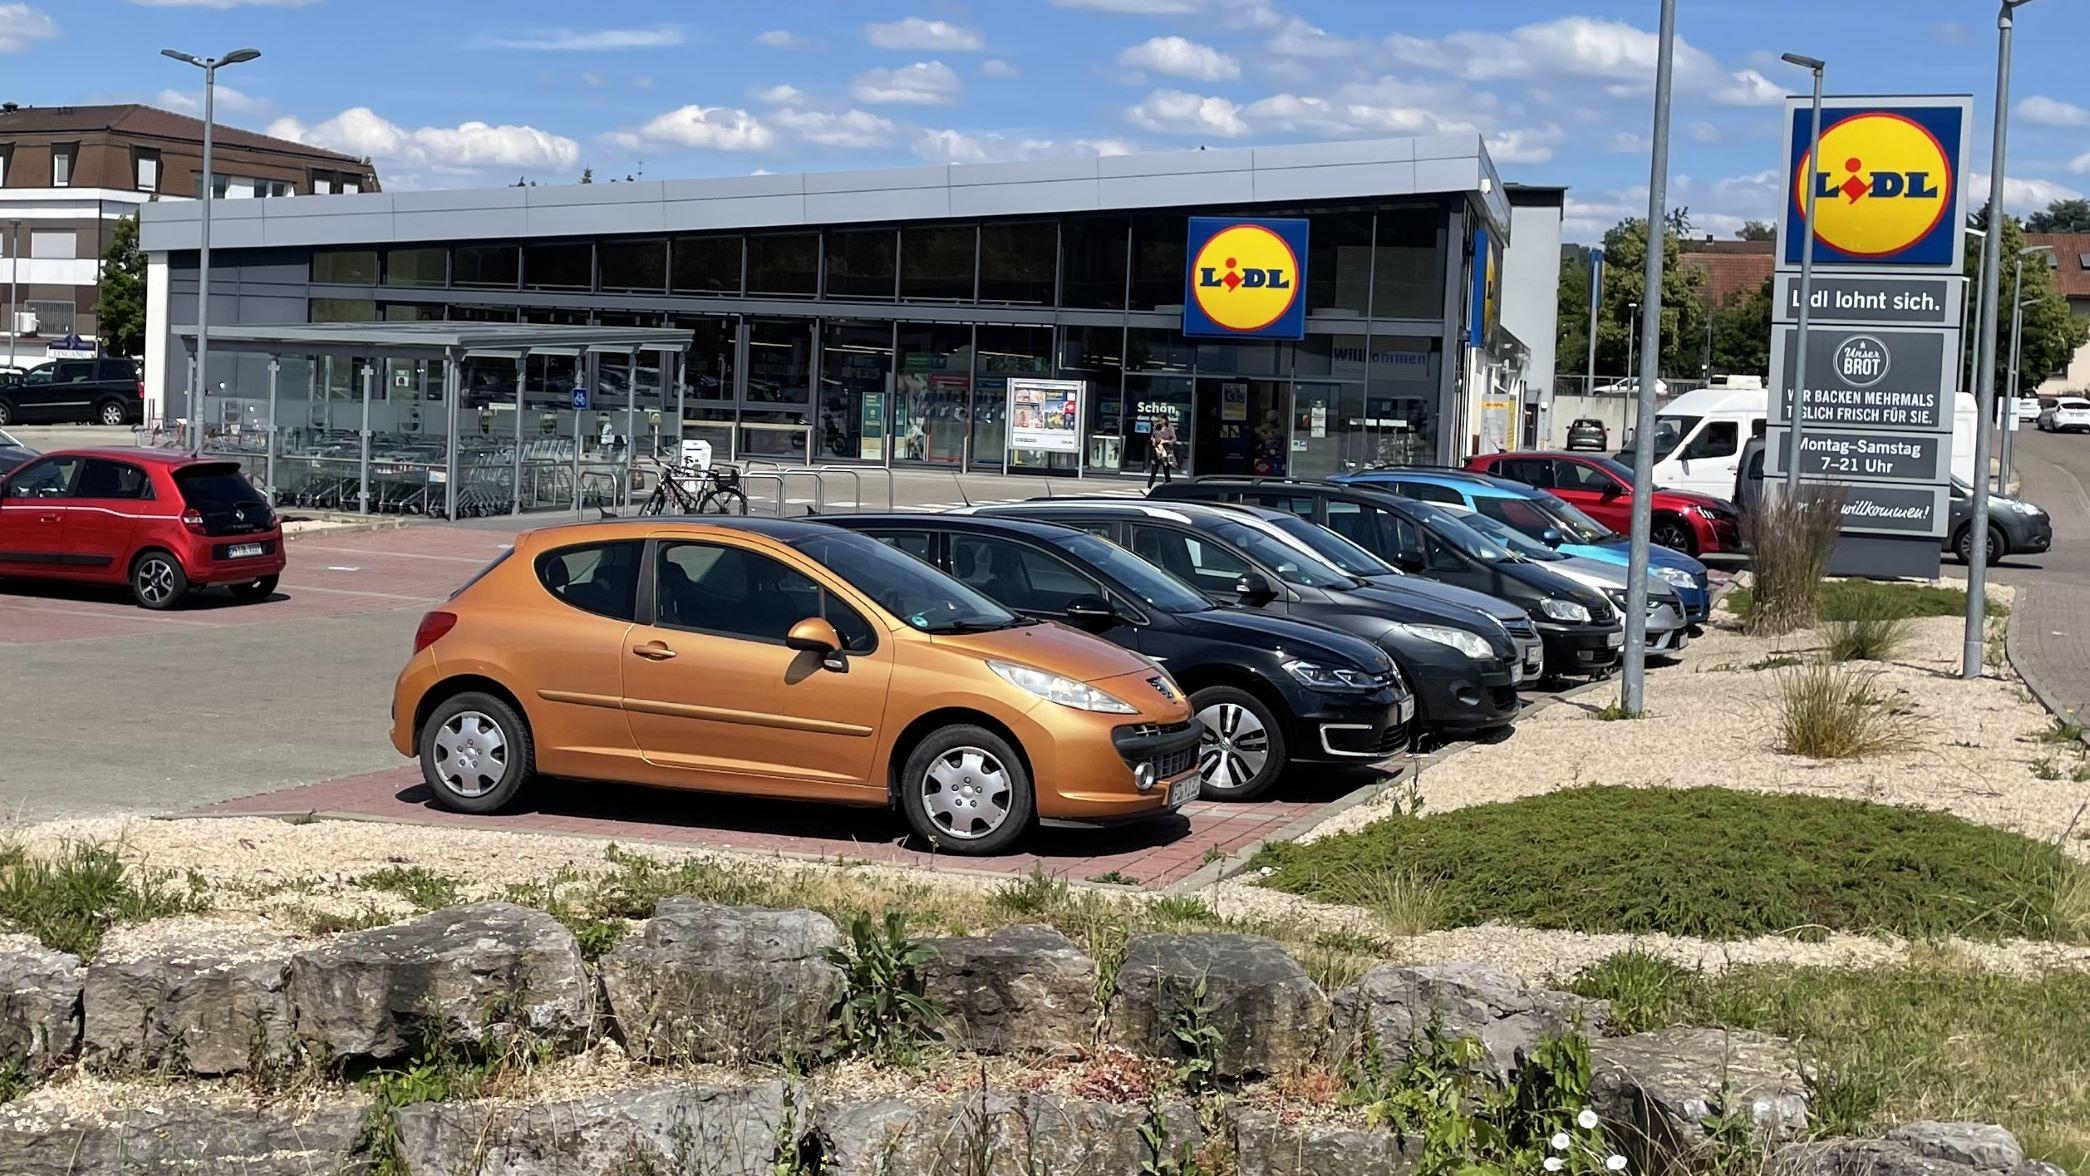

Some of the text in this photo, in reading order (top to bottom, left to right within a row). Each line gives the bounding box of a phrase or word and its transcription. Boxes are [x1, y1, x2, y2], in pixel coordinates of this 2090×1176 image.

[1792, 289, 1941, 311] Ldl lohnt sich.
[1843, 347, 1881, 360] Unser
[1843, 358, 1881, 376] BROT
[1814, 389, 1861, 405] BACKEN
[1864, 391, 1934, 407] MEHRMALS
[1137, 401, 1180, 417] Schön,
[1837, 407, 1880, 422] FRISCH
[1883, 407, 1906, 423] FÜR
[1910, 410, 1933, 424] SIE.
[1865, 459, 1894, 473] Uhr
[1841, 500, 1930, 520] willkommen!
